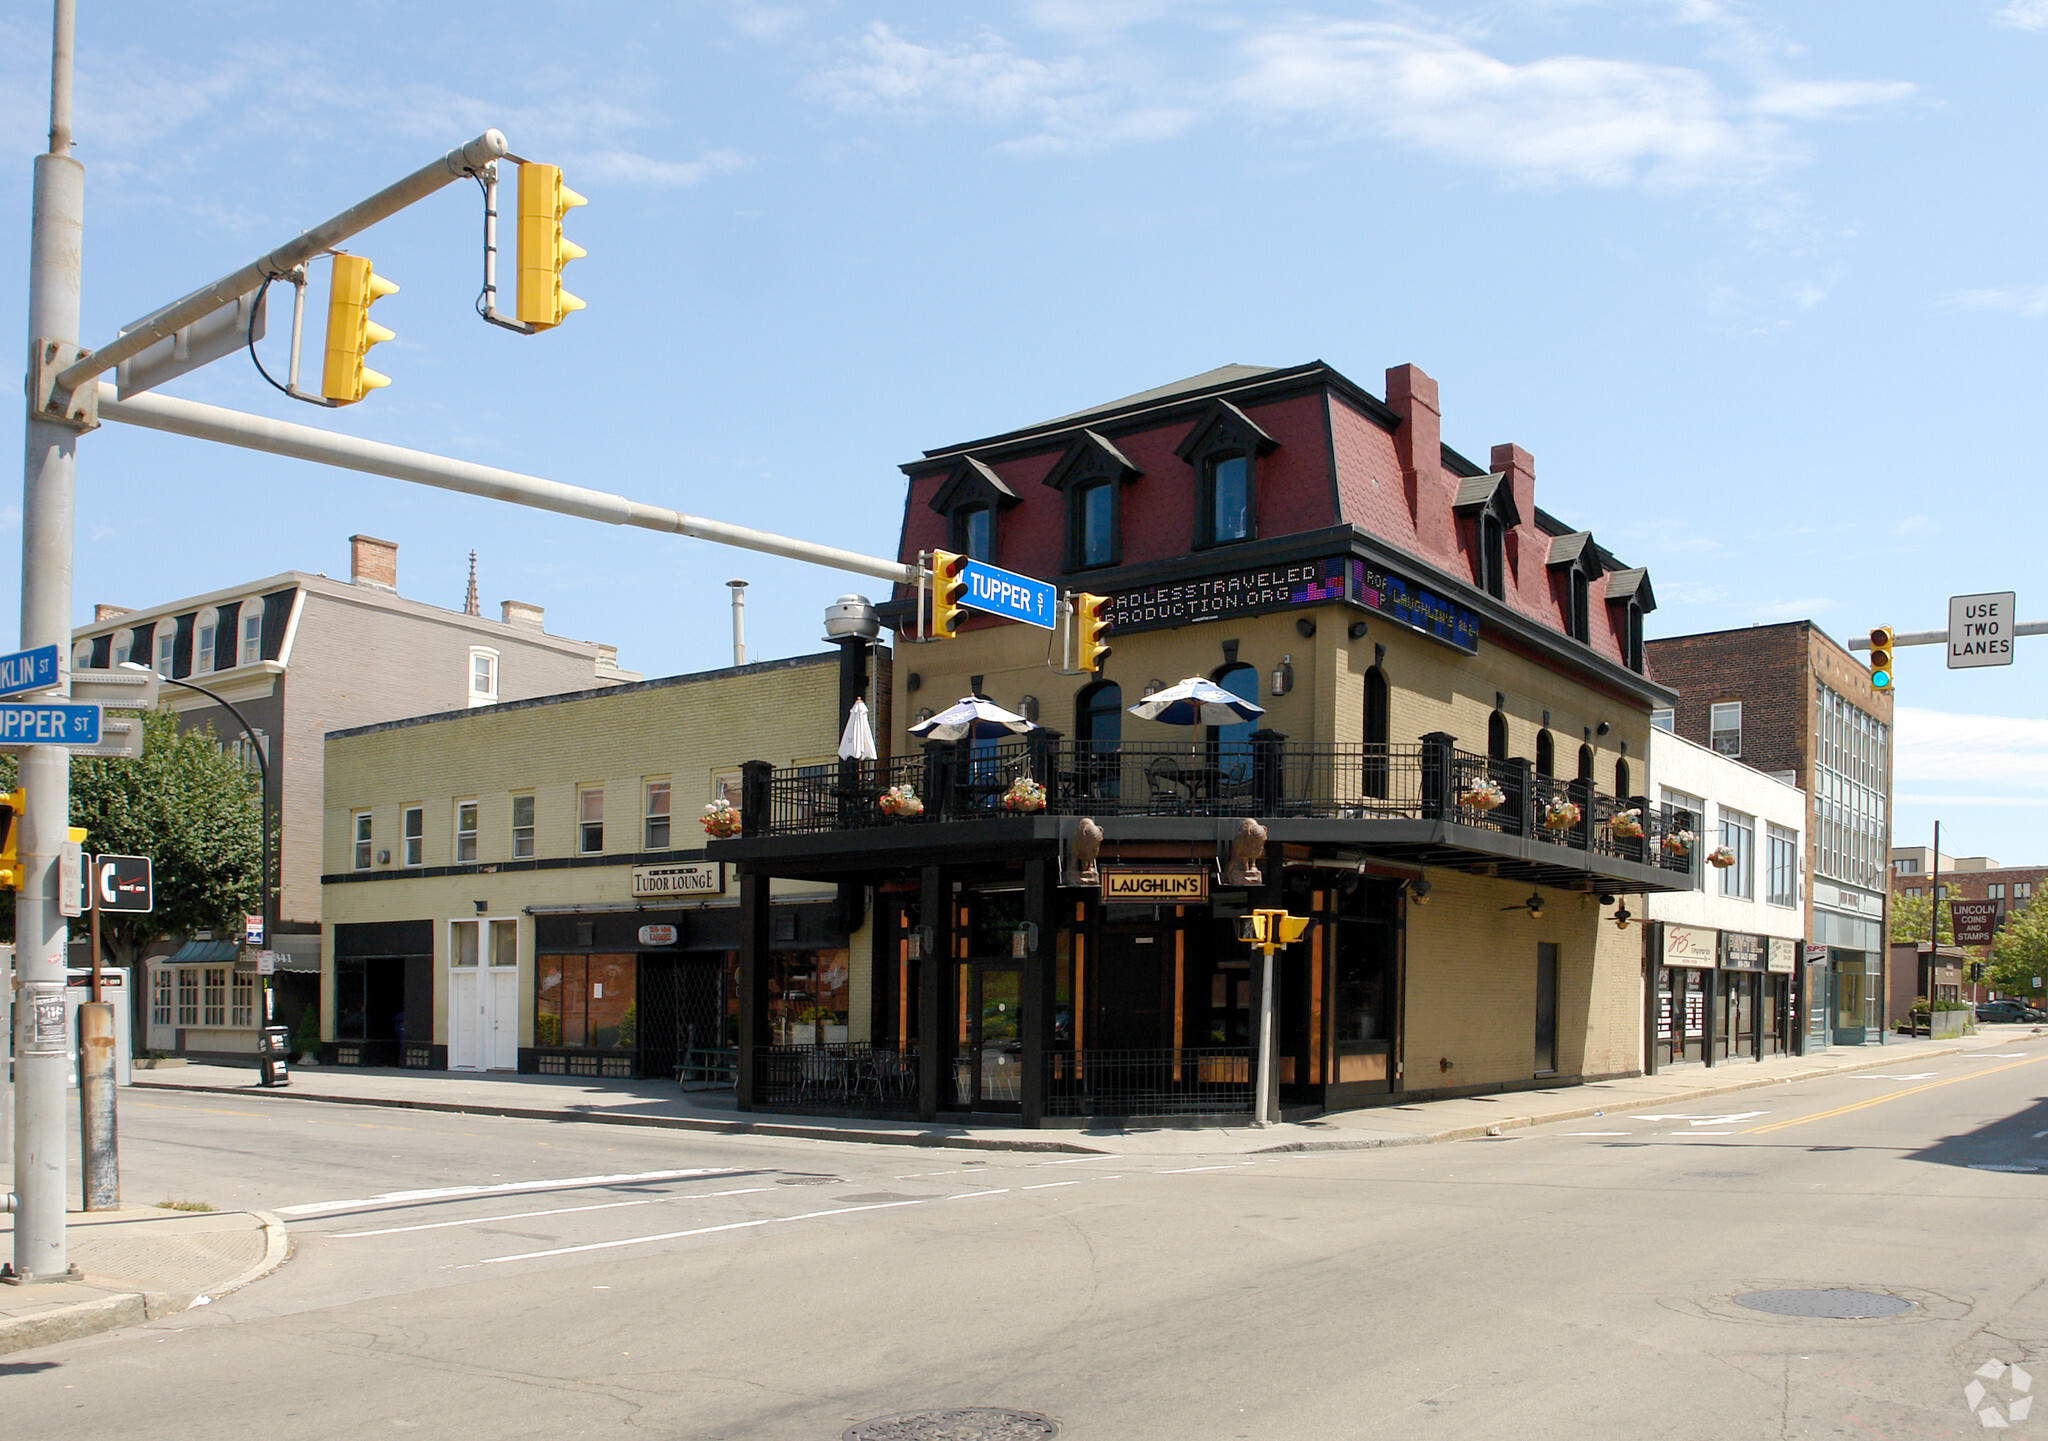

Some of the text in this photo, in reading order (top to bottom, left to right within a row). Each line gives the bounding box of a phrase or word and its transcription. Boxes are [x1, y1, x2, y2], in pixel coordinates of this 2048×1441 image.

[970, 571, 1031, 612] TUPPER
[1037, 592, 1043, 616] ST
[1104, 586, 1289, 625] PRODUCTION.ORG
[1966, 603, 1998, 618] USE
[1964, 622, 1999, 637] TWO
[1953, 639, 2010, 656] LANES
[39, 658, 49, 674] ST
[74, 717, 89, 732] ST
[635, 874, 669, 892] TUDOR
[672, 870, 714, 890] LOUNGE
[1111, 878, 1198, 893] LAUGHLIN'S
[1953, 905, 1995, 915] LINCOLN
[1961, 915, 1987, 923] COINS
[1957, 932, 1990, 941] STAMPS
[273, 953, 292, 962] 341
